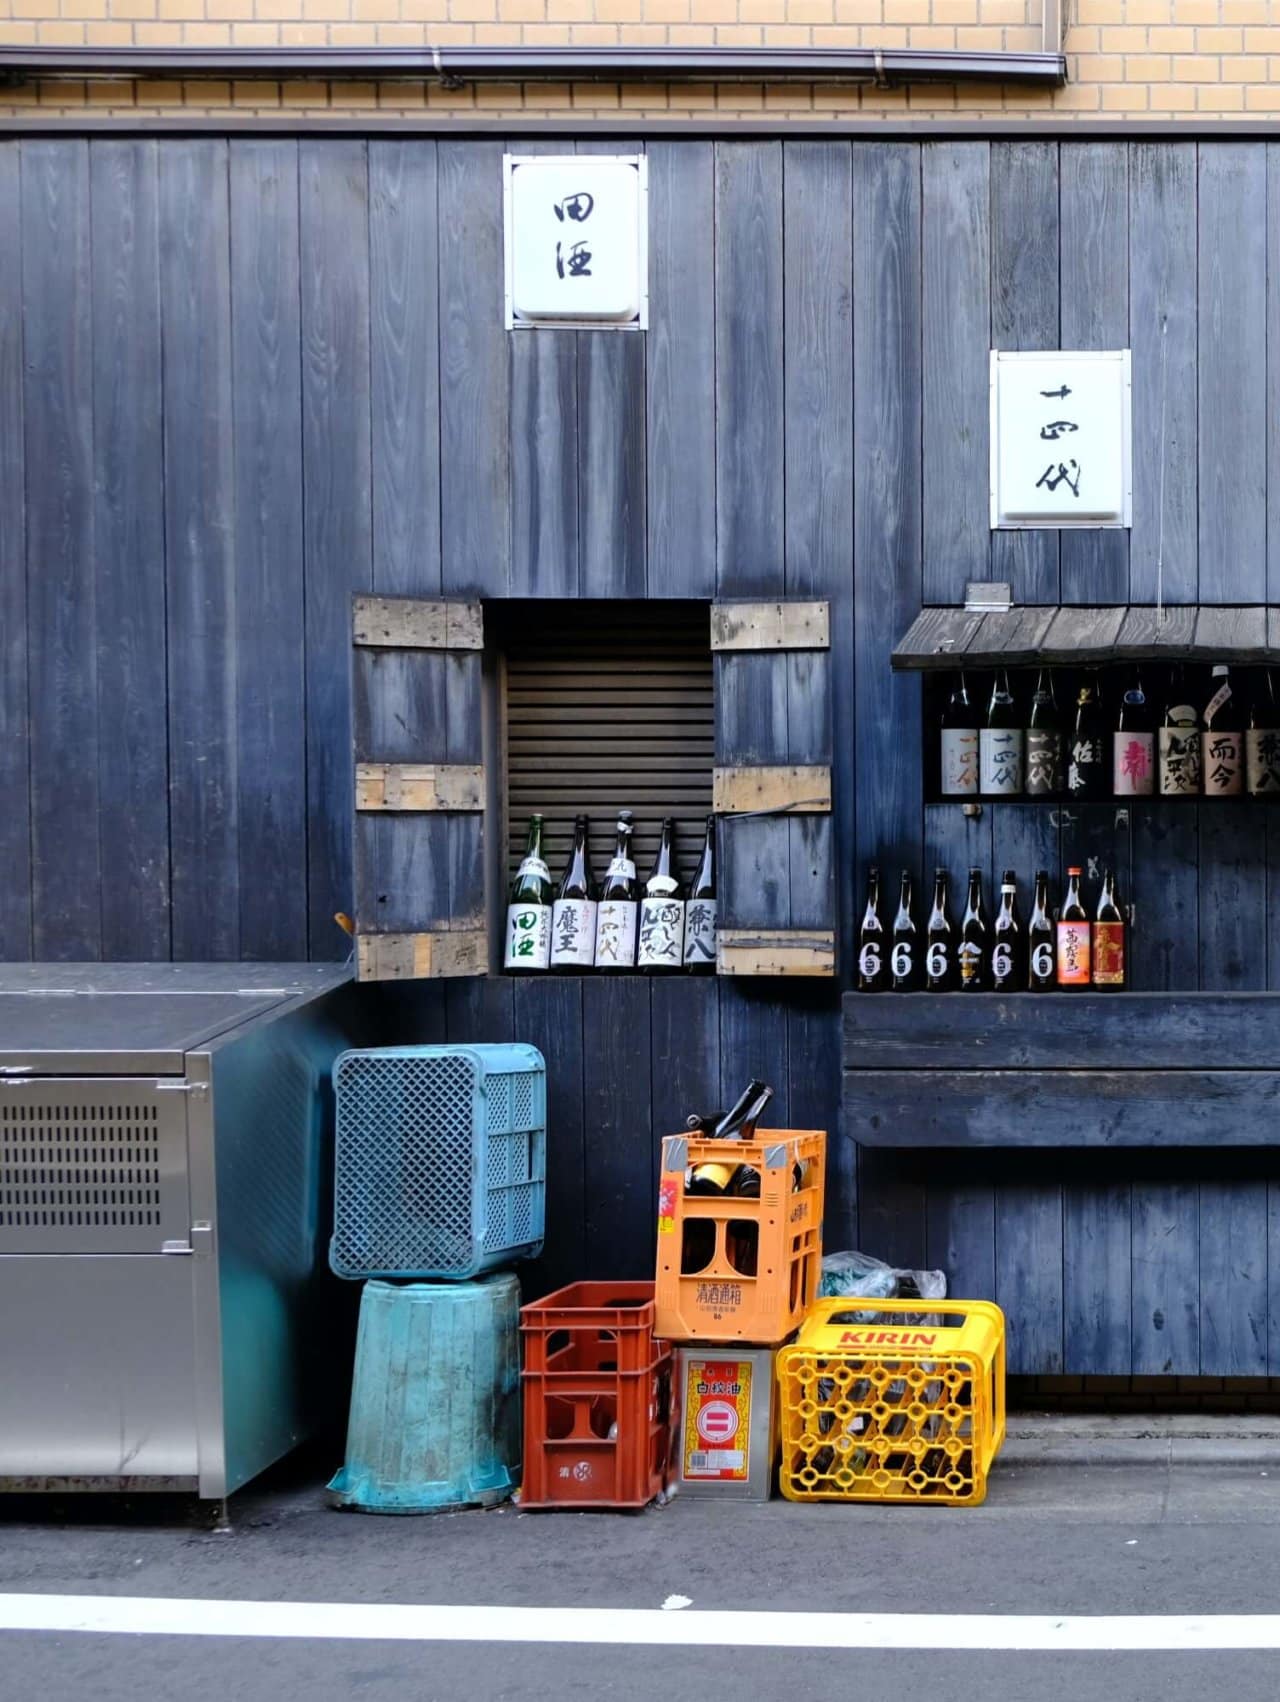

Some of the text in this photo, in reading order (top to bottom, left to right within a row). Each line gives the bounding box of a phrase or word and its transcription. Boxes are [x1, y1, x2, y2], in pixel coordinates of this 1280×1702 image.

[553, 192, 595, 279] 田酒
[1035, 384, 1083, 498] 十四代
[992, 734, 1017, 788] 十四代
[1209, 737, 1235, 788] 而今
[512, 911, 537, 958] 田酒
[555, 904, 579, 953] 魔王
[597, 905, 619, 961] 十四代
[685, 903, 716, 960] 兼八
[859, 942, 880, 976] 6
[891, 942, 912, 976] 6
[926, 942, 948, 976] 6
[992, 943, 1012, 977] 6
[1032, 943, 1053, 977] 6
[840, 1331, 937, 1346] KIRIN
